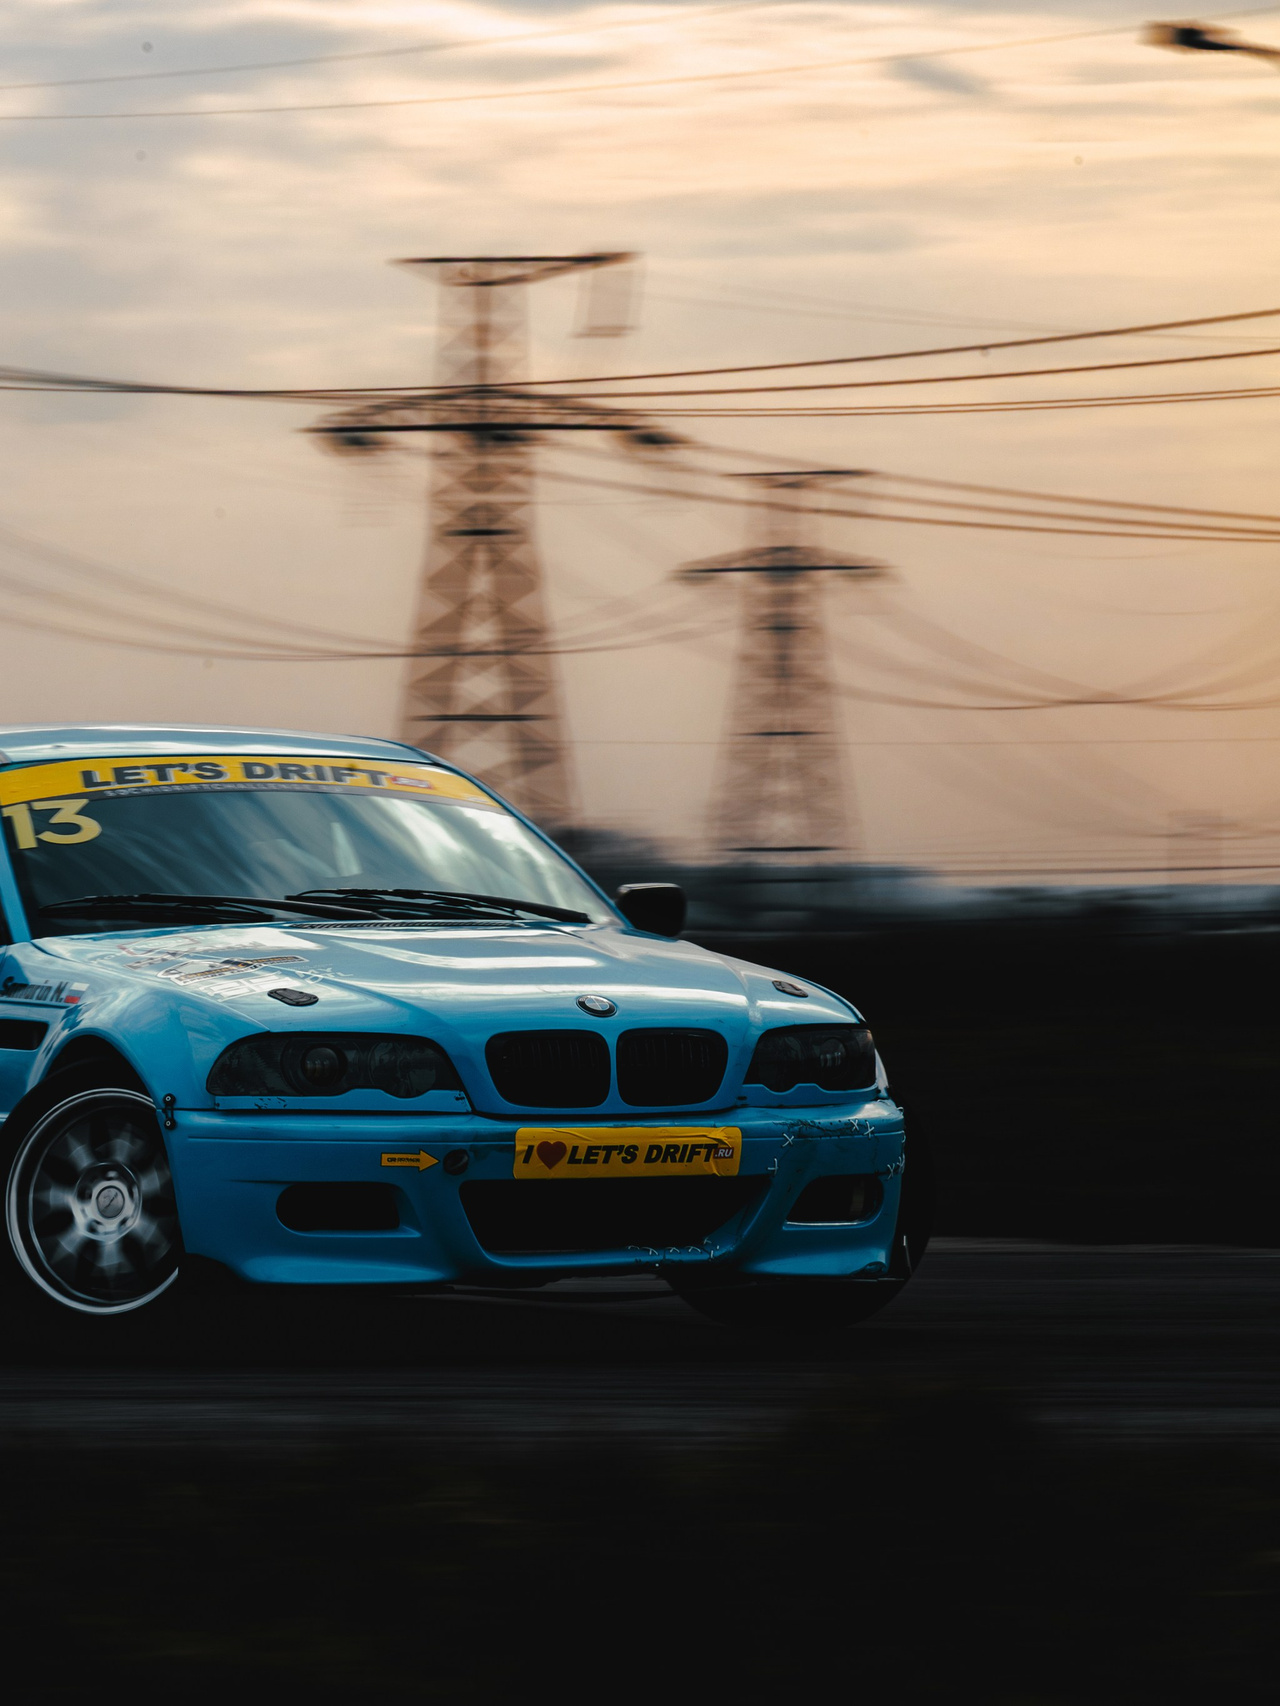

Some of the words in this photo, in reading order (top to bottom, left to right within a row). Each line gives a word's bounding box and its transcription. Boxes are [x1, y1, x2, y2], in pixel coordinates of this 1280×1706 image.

[81, 762, 227, 789] LET'S
[241, 762, 392, 787] DRIFT
[1, 798, 102, 850] 13
[522, 1144, 535, 1164] I
[567, 1144, 641, 1165] LET'S
